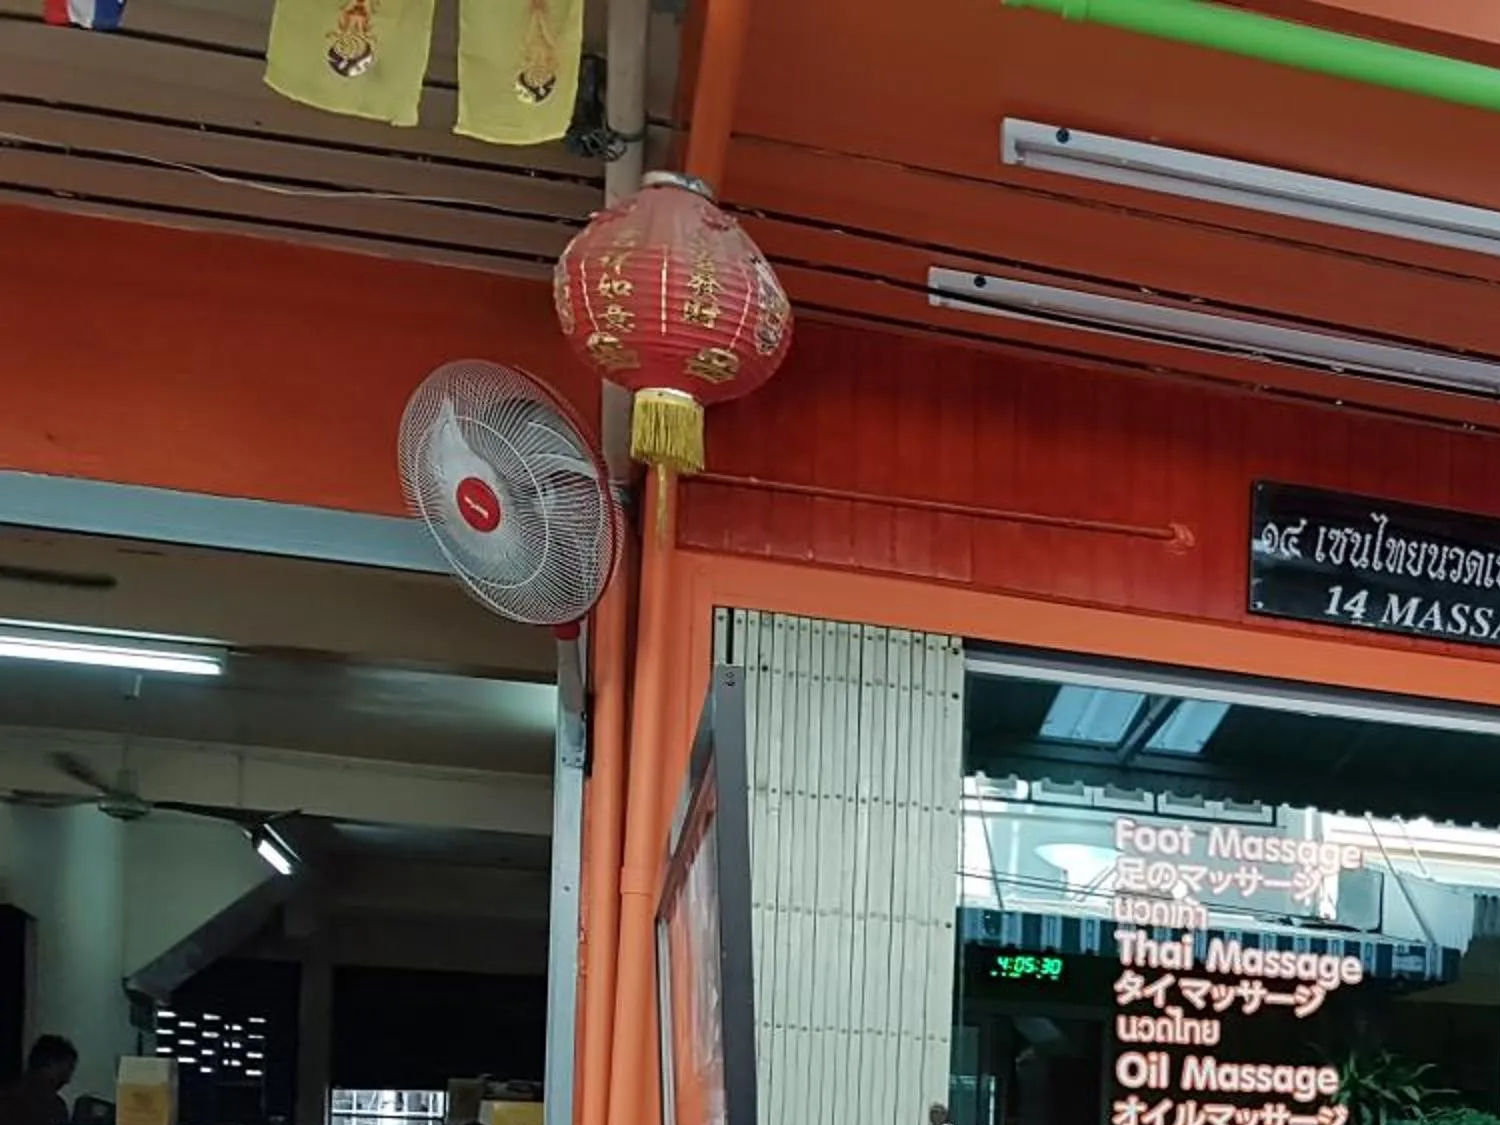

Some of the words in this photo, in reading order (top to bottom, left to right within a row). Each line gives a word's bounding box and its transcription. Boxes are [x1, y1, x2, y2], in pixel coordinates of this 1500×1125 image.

[1262, 518, 1308, 559] ๑๔
[1324, 584, 1369, 620] 14
[1114, 819, 1194, 856] Foot
[1208, 826, 1362, 874] Massage
[1115, 857, 1324, 901] 足のマッサージ
[1113, 930, 1193, 968] Thai
[1205, 938, 1363, 988] Massage
[1113, 970, 1327, 1018] タイマッサージ
[1116, 1006, 1221, 1046] นวดไทย
[1115, 1052, 1170, 1090] Oil
[1181, 1056, 1340, 1101] Massage
